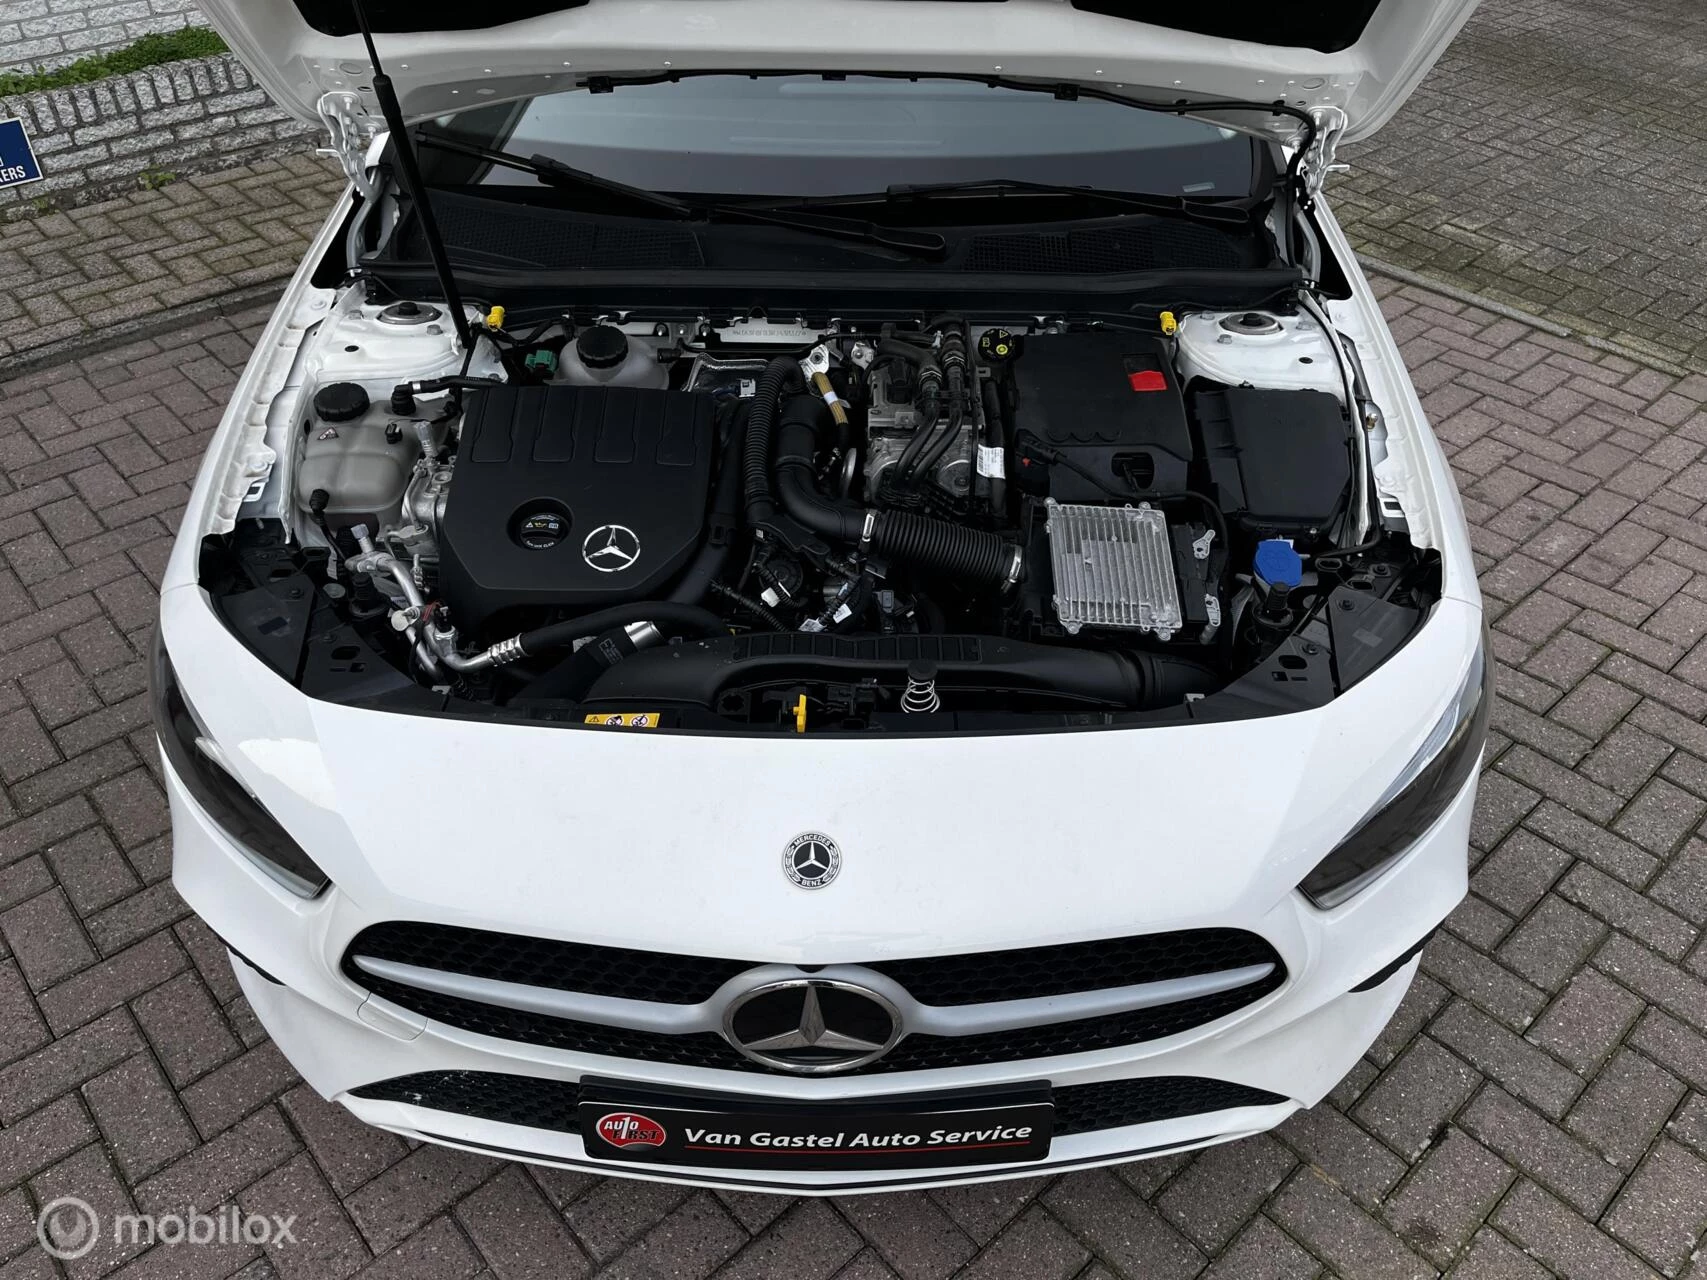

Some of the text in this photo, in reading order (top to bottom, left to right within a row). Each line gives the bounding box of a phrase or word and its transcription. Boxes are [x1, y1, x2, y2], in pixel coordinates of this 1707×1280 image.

[794, 834, 831, 847] MERCEDES
[685, 1126, 1033, 1148] Van Gastel Auto Service
